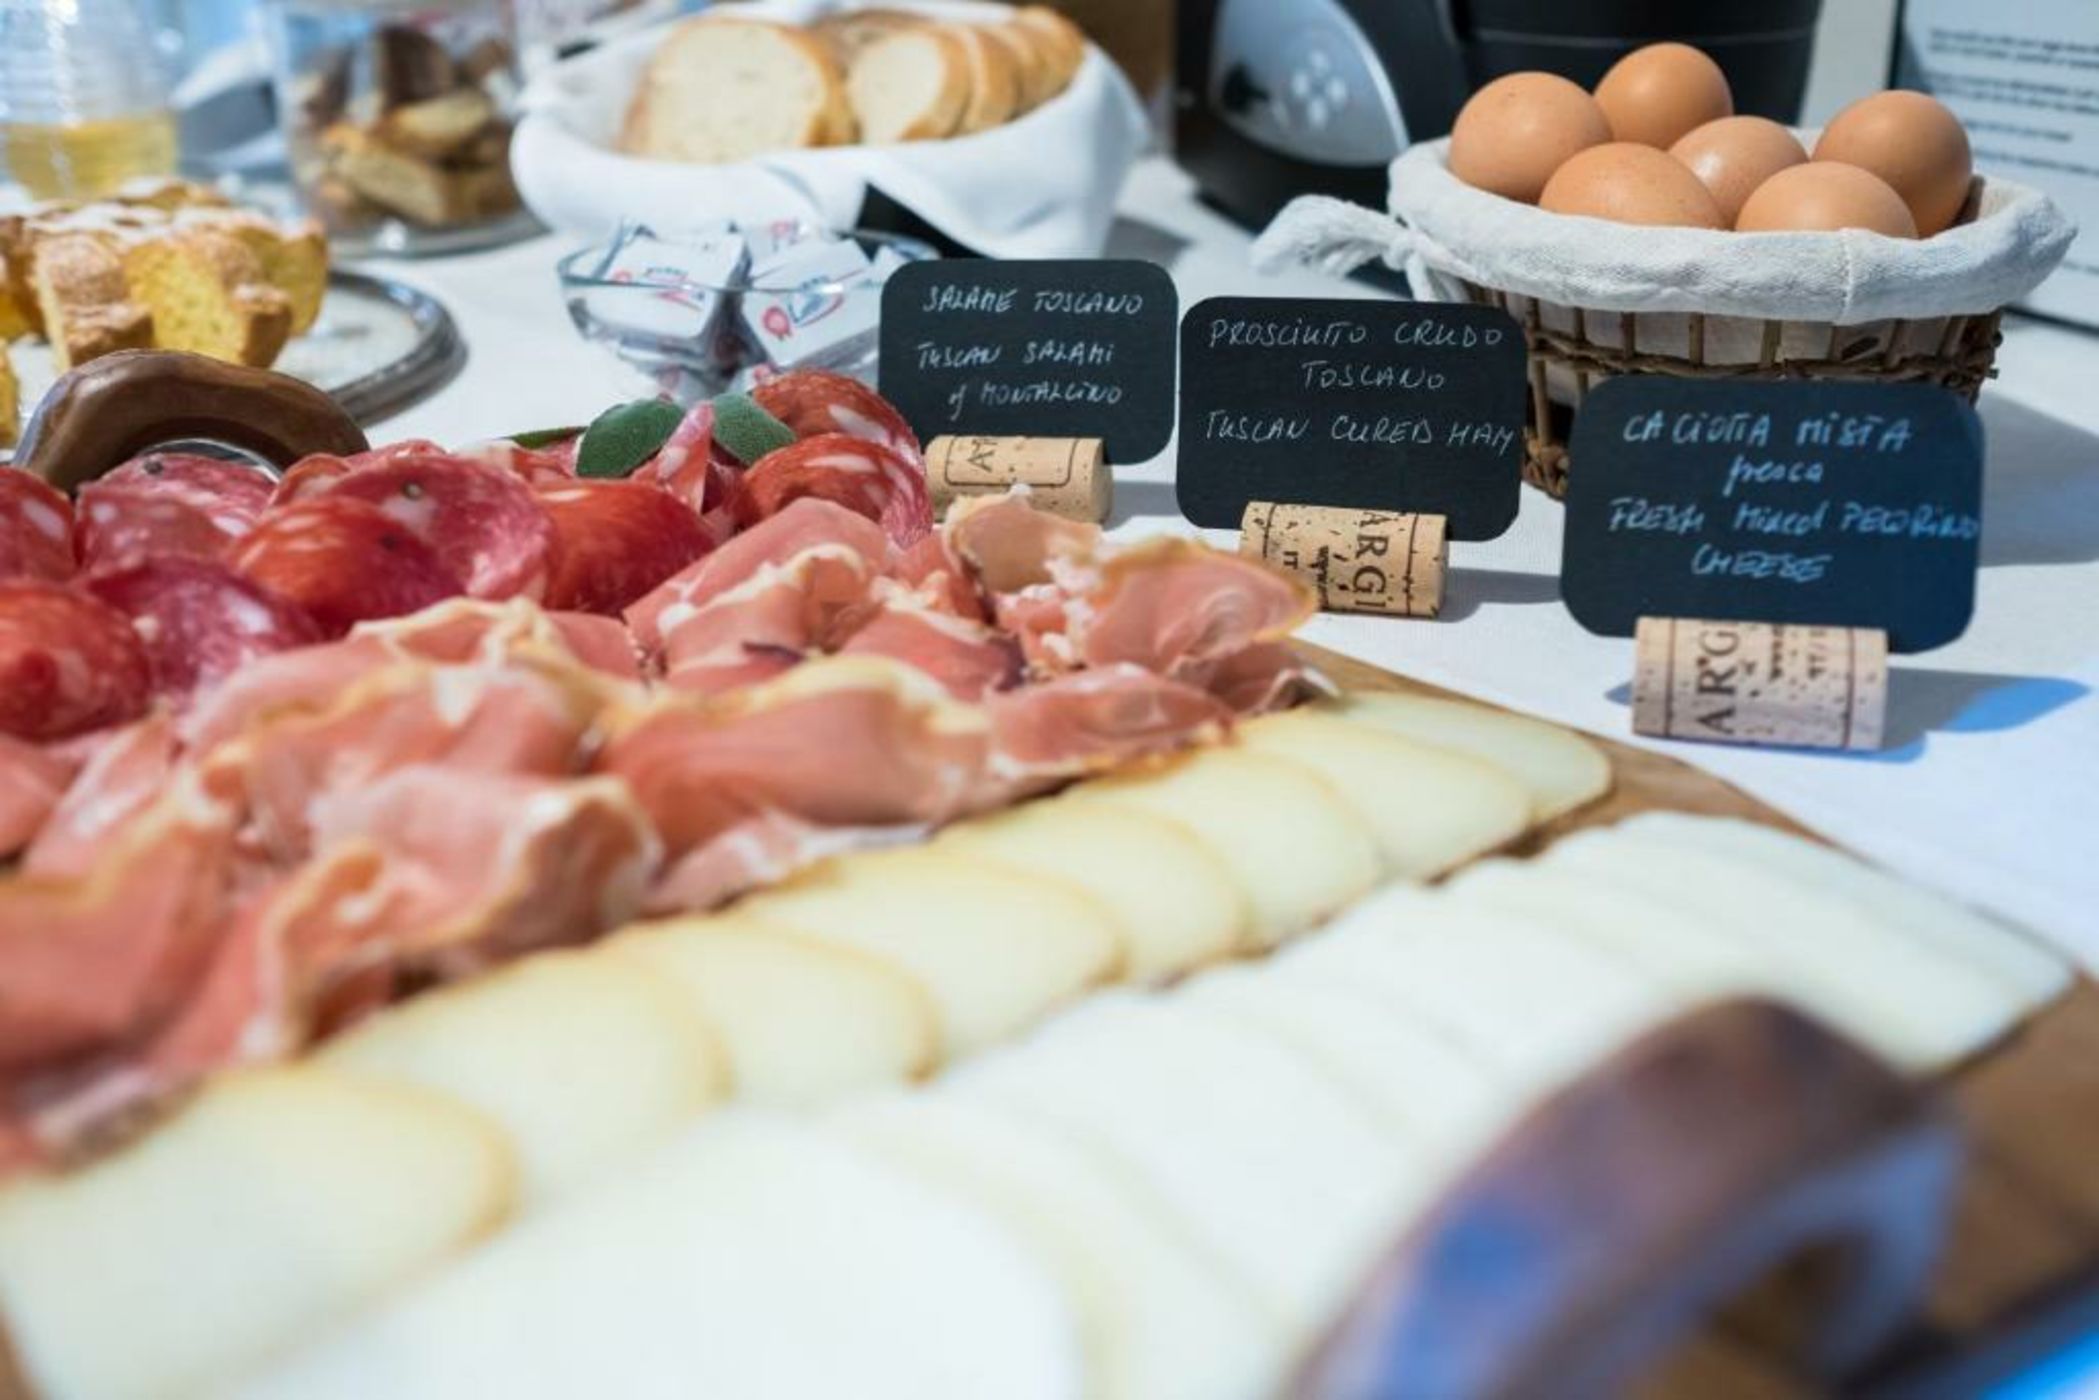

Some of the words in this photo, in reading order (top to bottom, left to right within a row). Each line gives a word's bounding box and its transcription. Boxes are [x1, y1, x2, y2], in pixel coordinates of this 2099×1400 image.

[922, 284, 1019, 313] SALAME
[1031, 291, 1143, 315] TOSCANO
[1394, 318, 1503, 347] CRUDO
[1301, 359, 1445, 389] TOSCANO
[1796, 411, 1912, 451] MISTA
[1690, 542, 1833, 583] CHEESE
